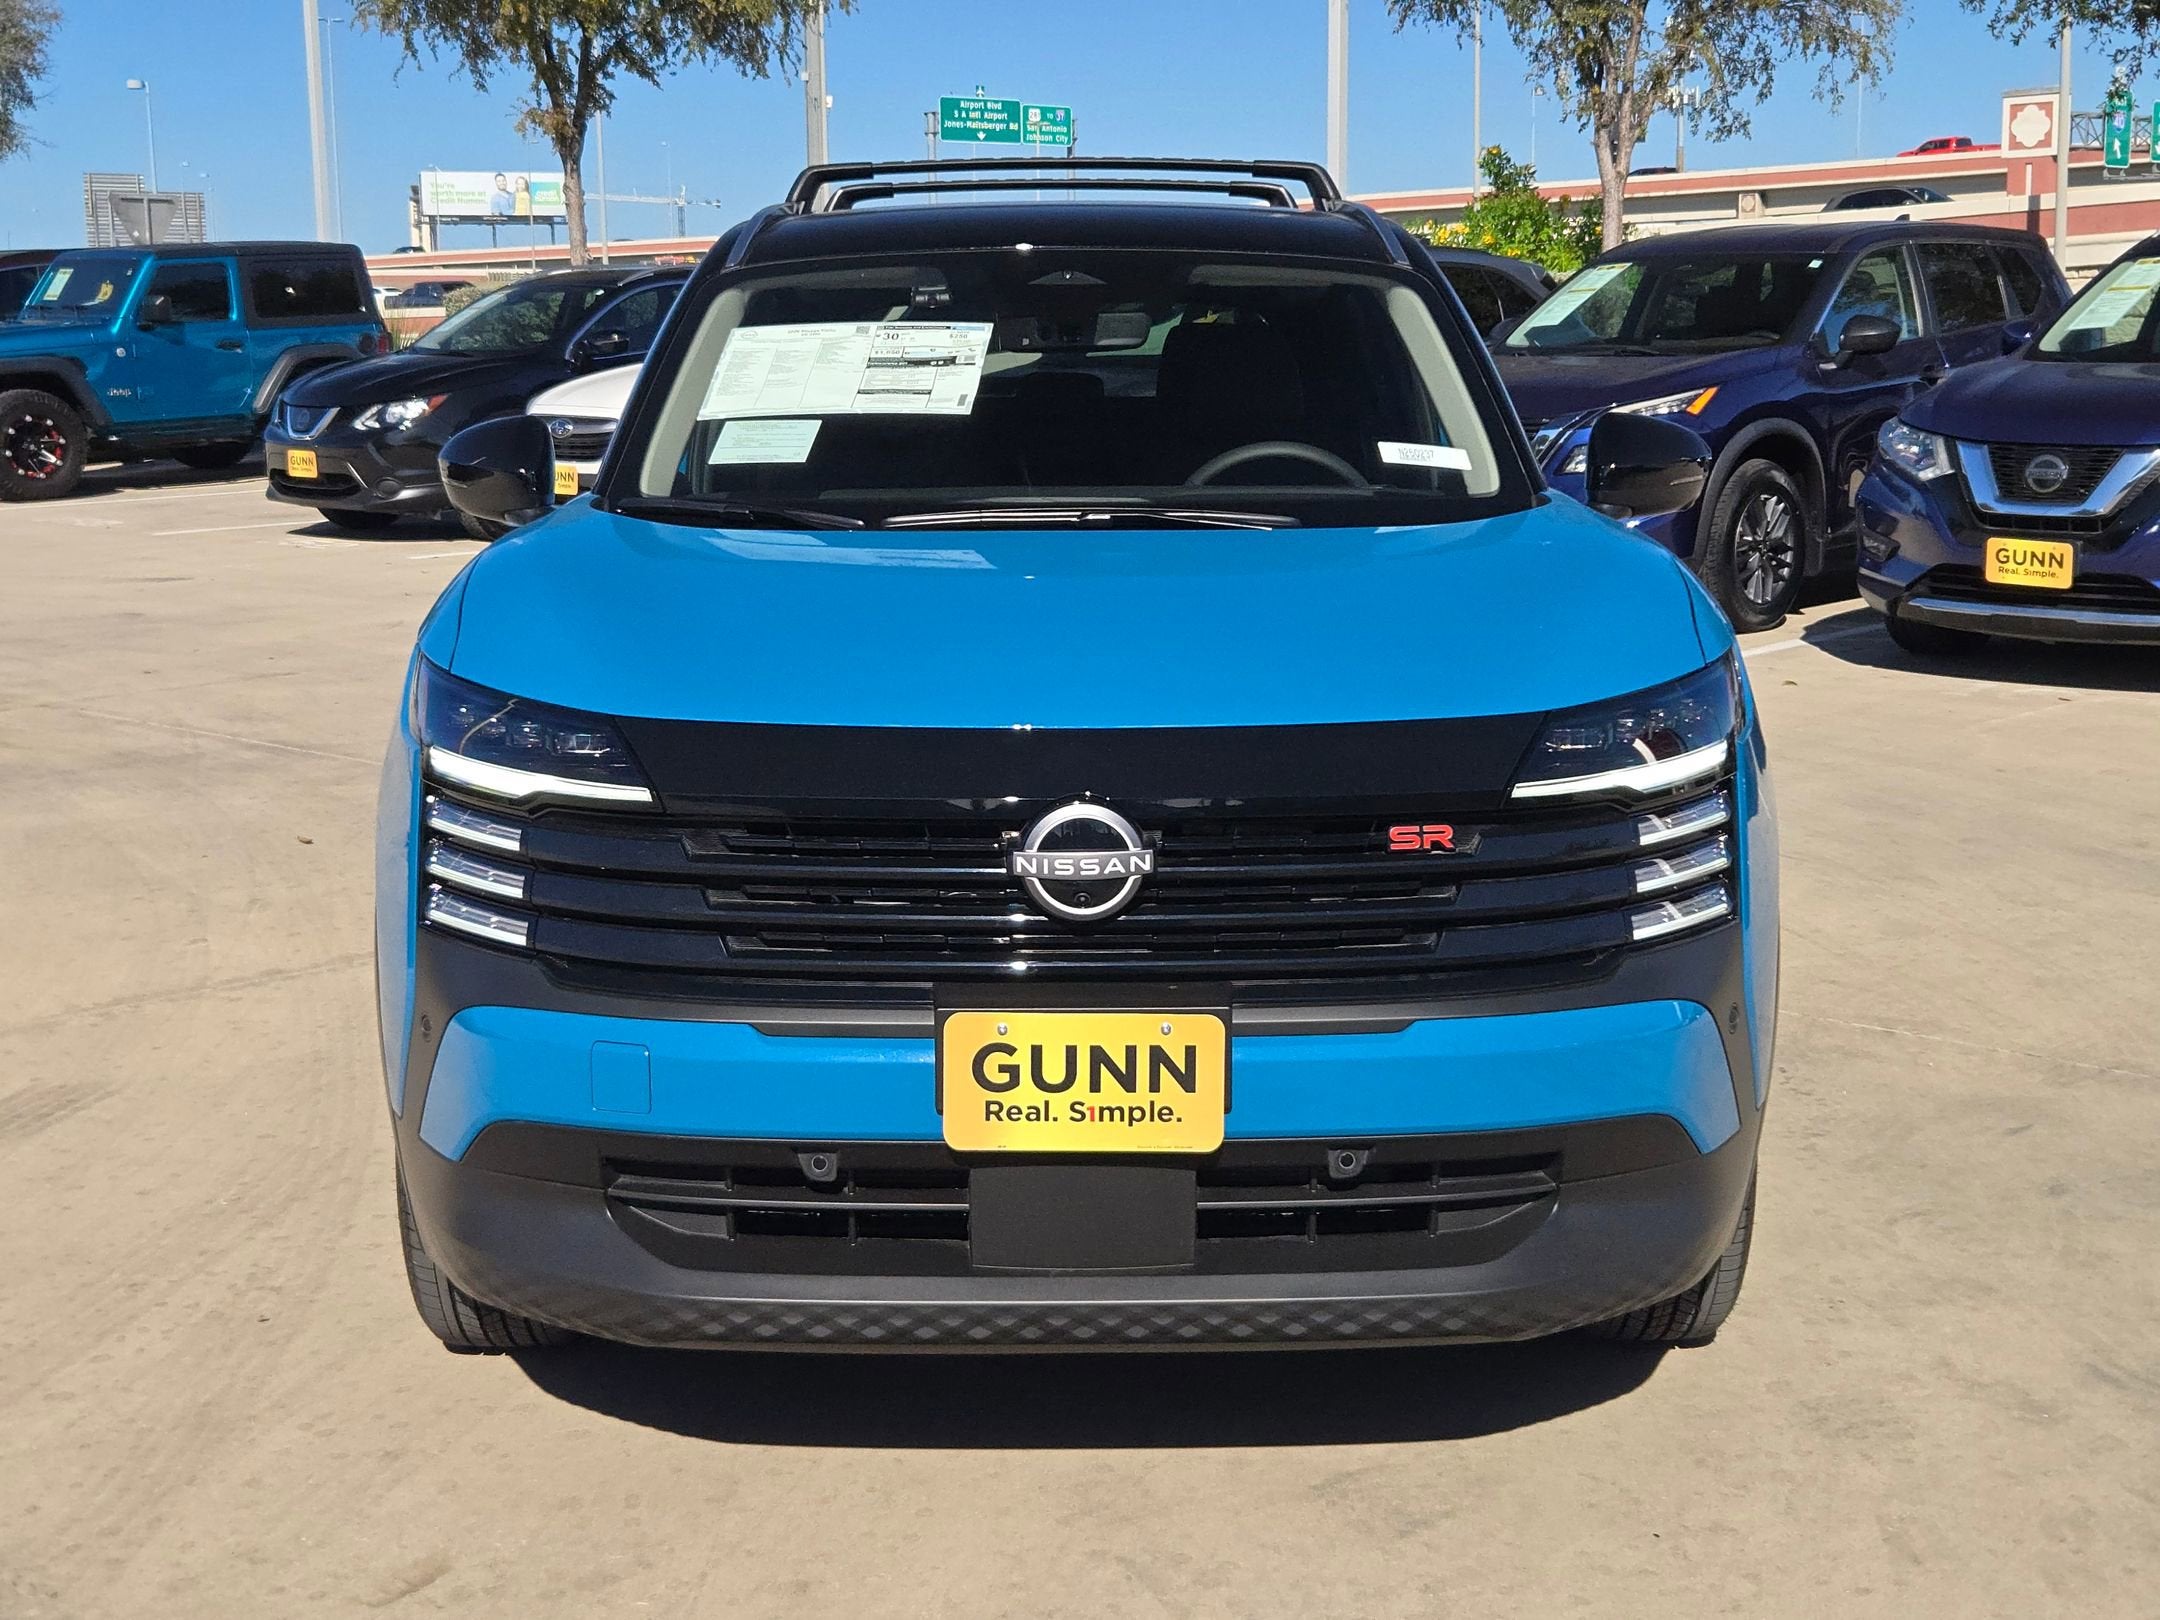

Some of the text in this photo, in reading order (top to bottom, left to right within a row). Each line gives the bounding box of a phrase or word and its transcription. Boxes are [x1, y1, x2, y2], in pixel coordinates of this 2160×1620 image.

[960, 101, 1002, 110] Airport Blvd
[954, 110, 959, 118] S
[984, 112, 1008, 121] Airport
[1041, 125, 1067, 133] Antonio
[1055, 134, 1069, 144] City
[882, 333, 899, 341] 30
[290, 455, 314, 466] GUNN
[554, 472, 575, 483] UNN
[1995, 547, 2064, 570] GUNN
[1389, 824, 1455, 851] SR
[1015, 853, 1152, 878] NISSAN
[971, 1042, 1197, 1094] GUNN
[984, 1100, 1059, 1123] Real.
